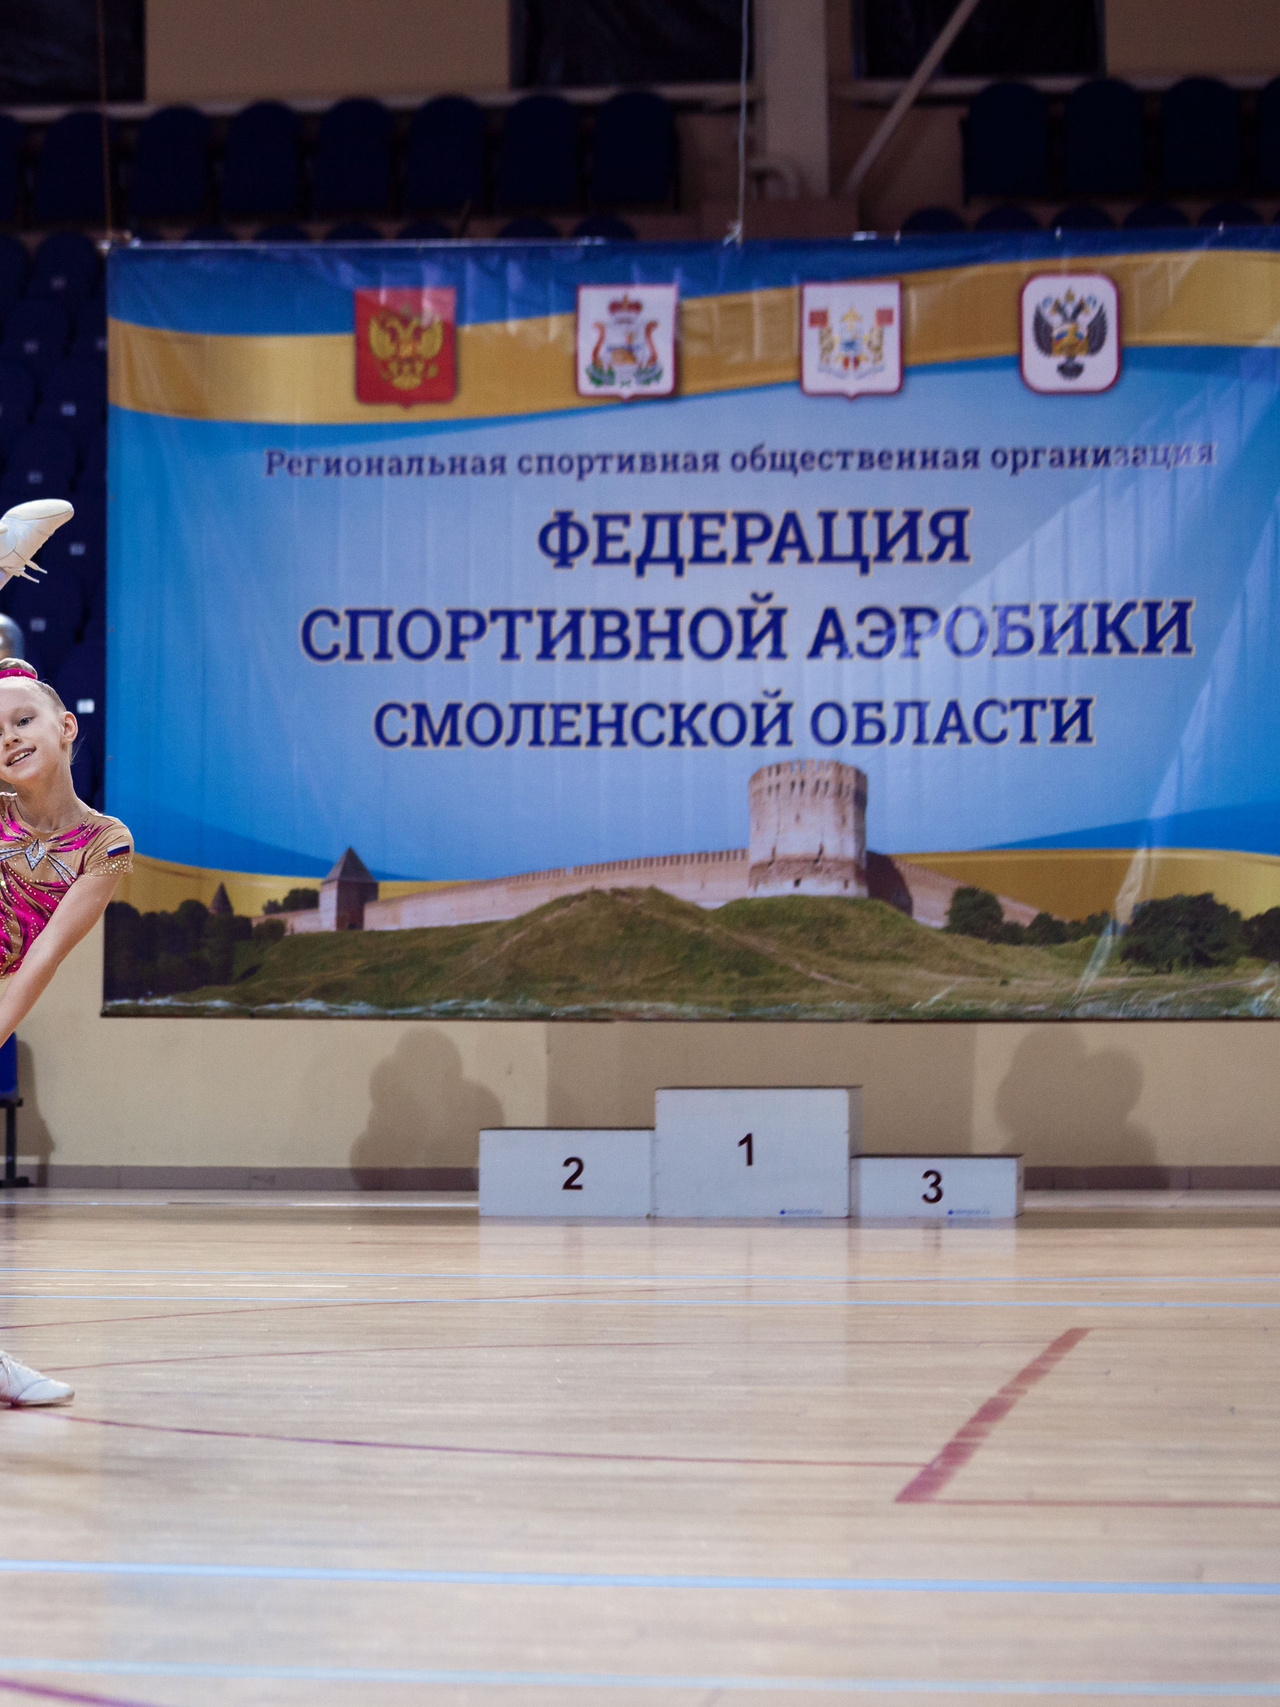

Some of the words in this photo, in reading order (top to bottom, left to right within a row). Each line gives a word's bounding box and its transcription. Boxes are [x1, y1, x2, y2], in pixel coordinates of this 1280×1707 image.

[264, 449, 507, 477] Региональная
[519, 449, 720, 481] спортивная
[730, 442, 980, 476] общественная
[991, 440, 1217, 476] организация
[538, 508, 971, 577] ФЕДЕРАЦИЯ
[301, 592, 789, 664] СПОРТИВНОЙ
[806, 600, 1194, 659] АЭРОБИКИ
[373, 691, 793, 749] СМОЛЕНСКОЙ
[810, 697, 1094, 747] ОБЛАСТИ
[737, 1133, 755, 1167] 1
[561, 1157, 585, 1191] 2
[921, 1170, 944, 1204] 3
